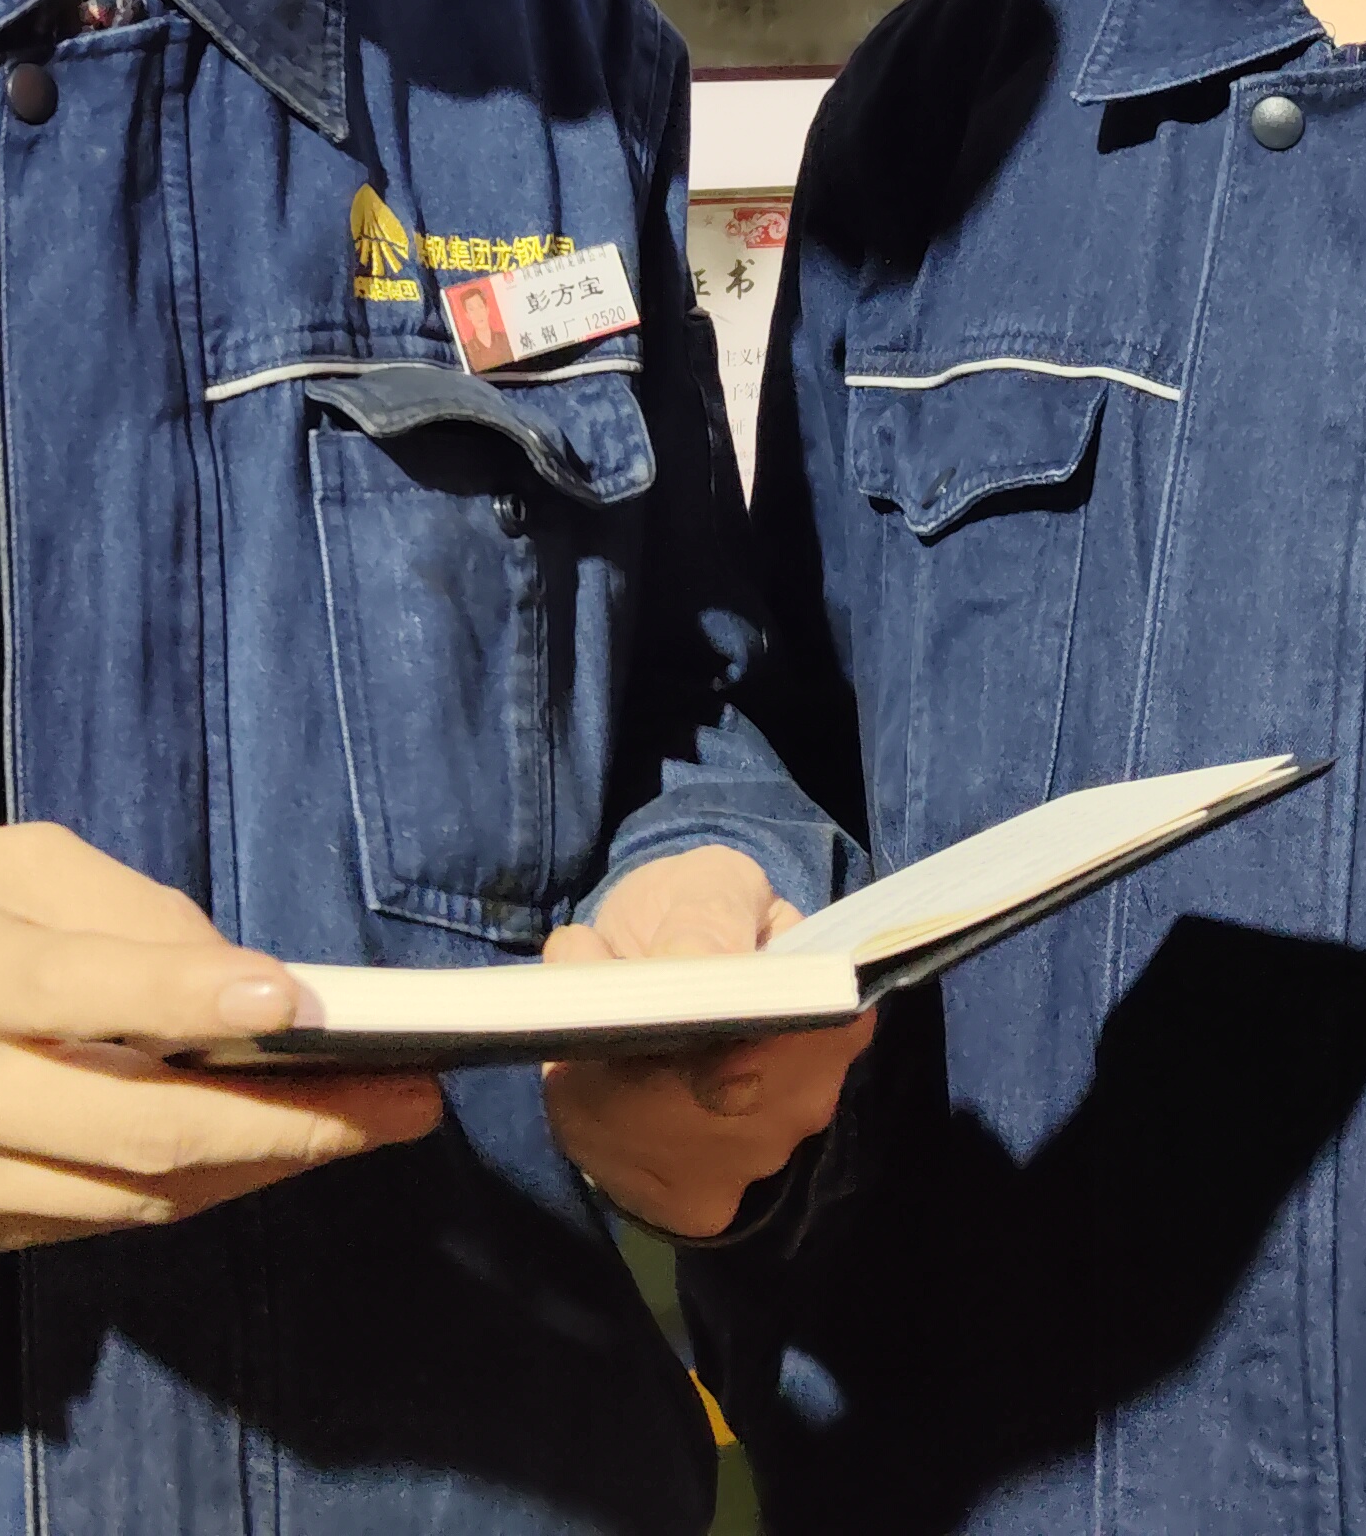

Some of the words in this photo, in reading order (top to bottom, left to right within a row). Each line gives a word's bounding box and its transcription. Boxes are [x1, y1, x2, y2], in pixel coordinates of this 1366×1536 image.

[525, 275, 606, 315] 彭方宝
[519, 318, 577, 352] 炼钢厂
[584, 305, 627, 332] 12520
